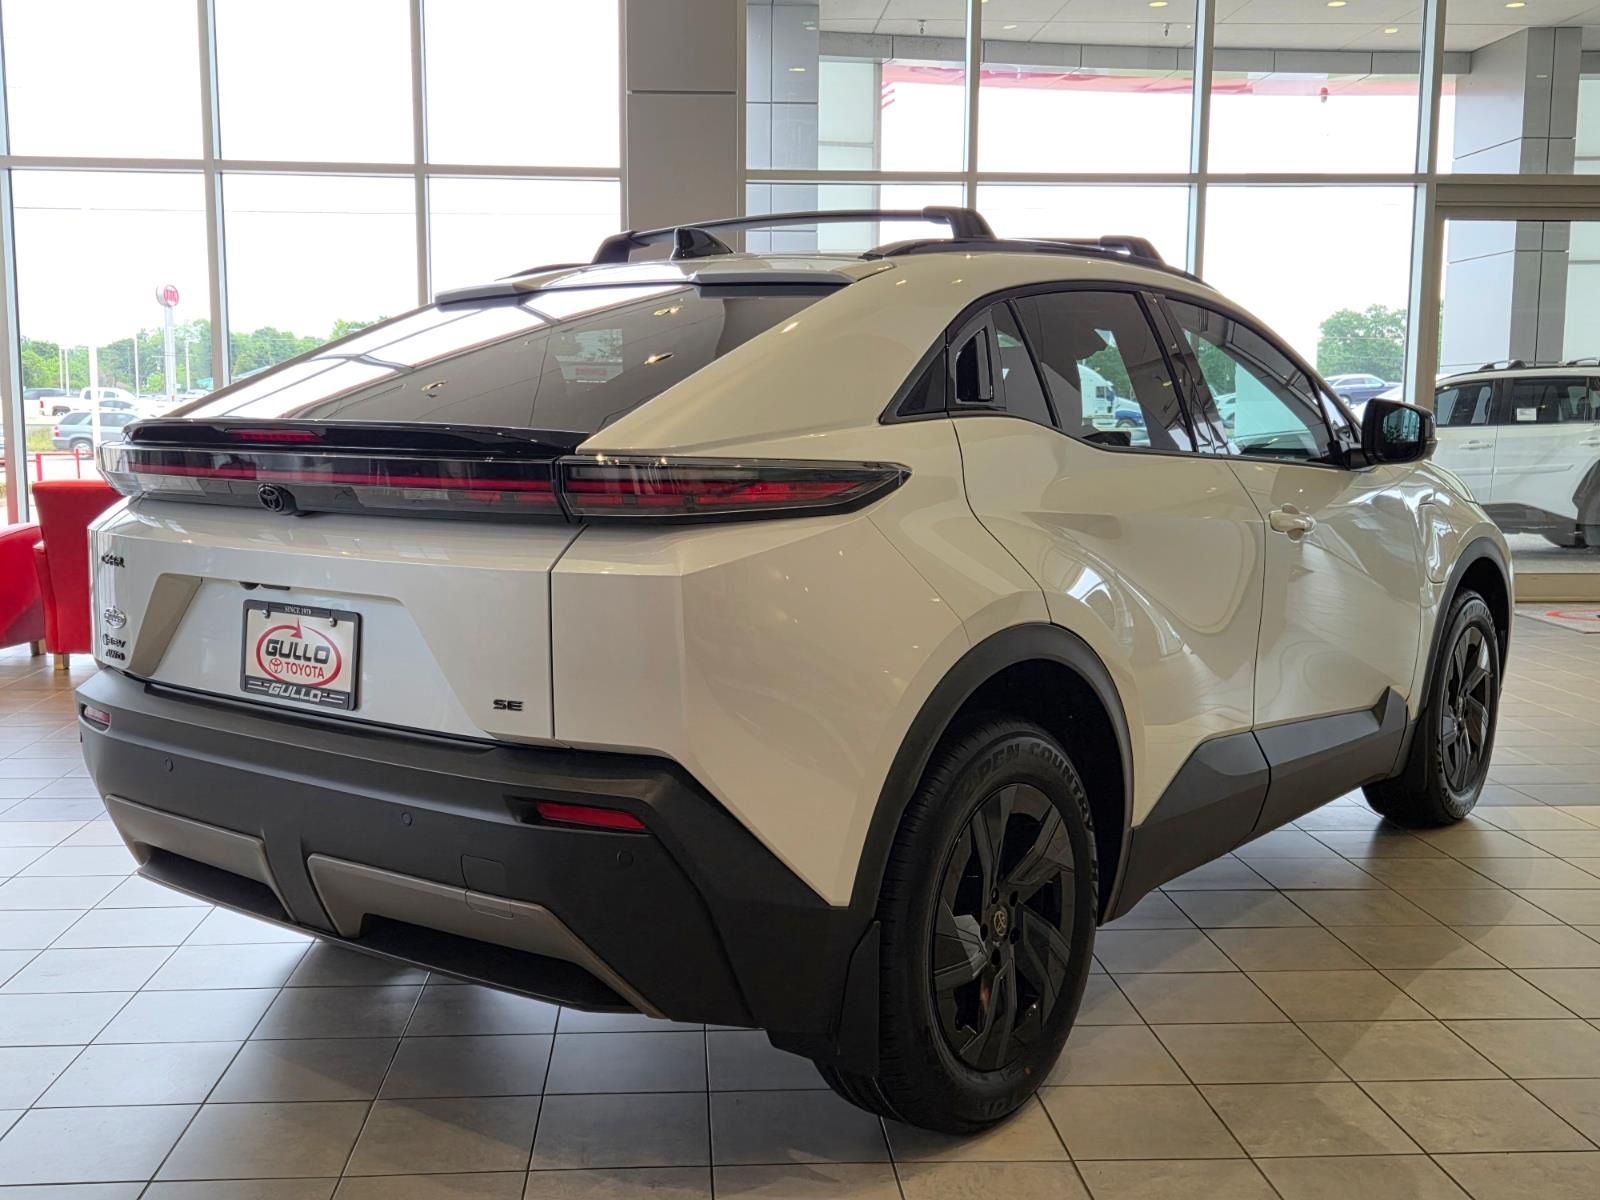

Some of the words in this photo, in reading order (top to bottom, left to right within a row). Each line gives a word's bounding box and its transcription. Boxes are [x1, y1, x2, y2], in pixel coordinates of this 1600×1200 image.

[265, 638, 330, 664] GULLO
[285, 661, 325, 679] TOYOTA
[269, 682, 322, 703] GULLO
[493, 699, 523, 712] SE
